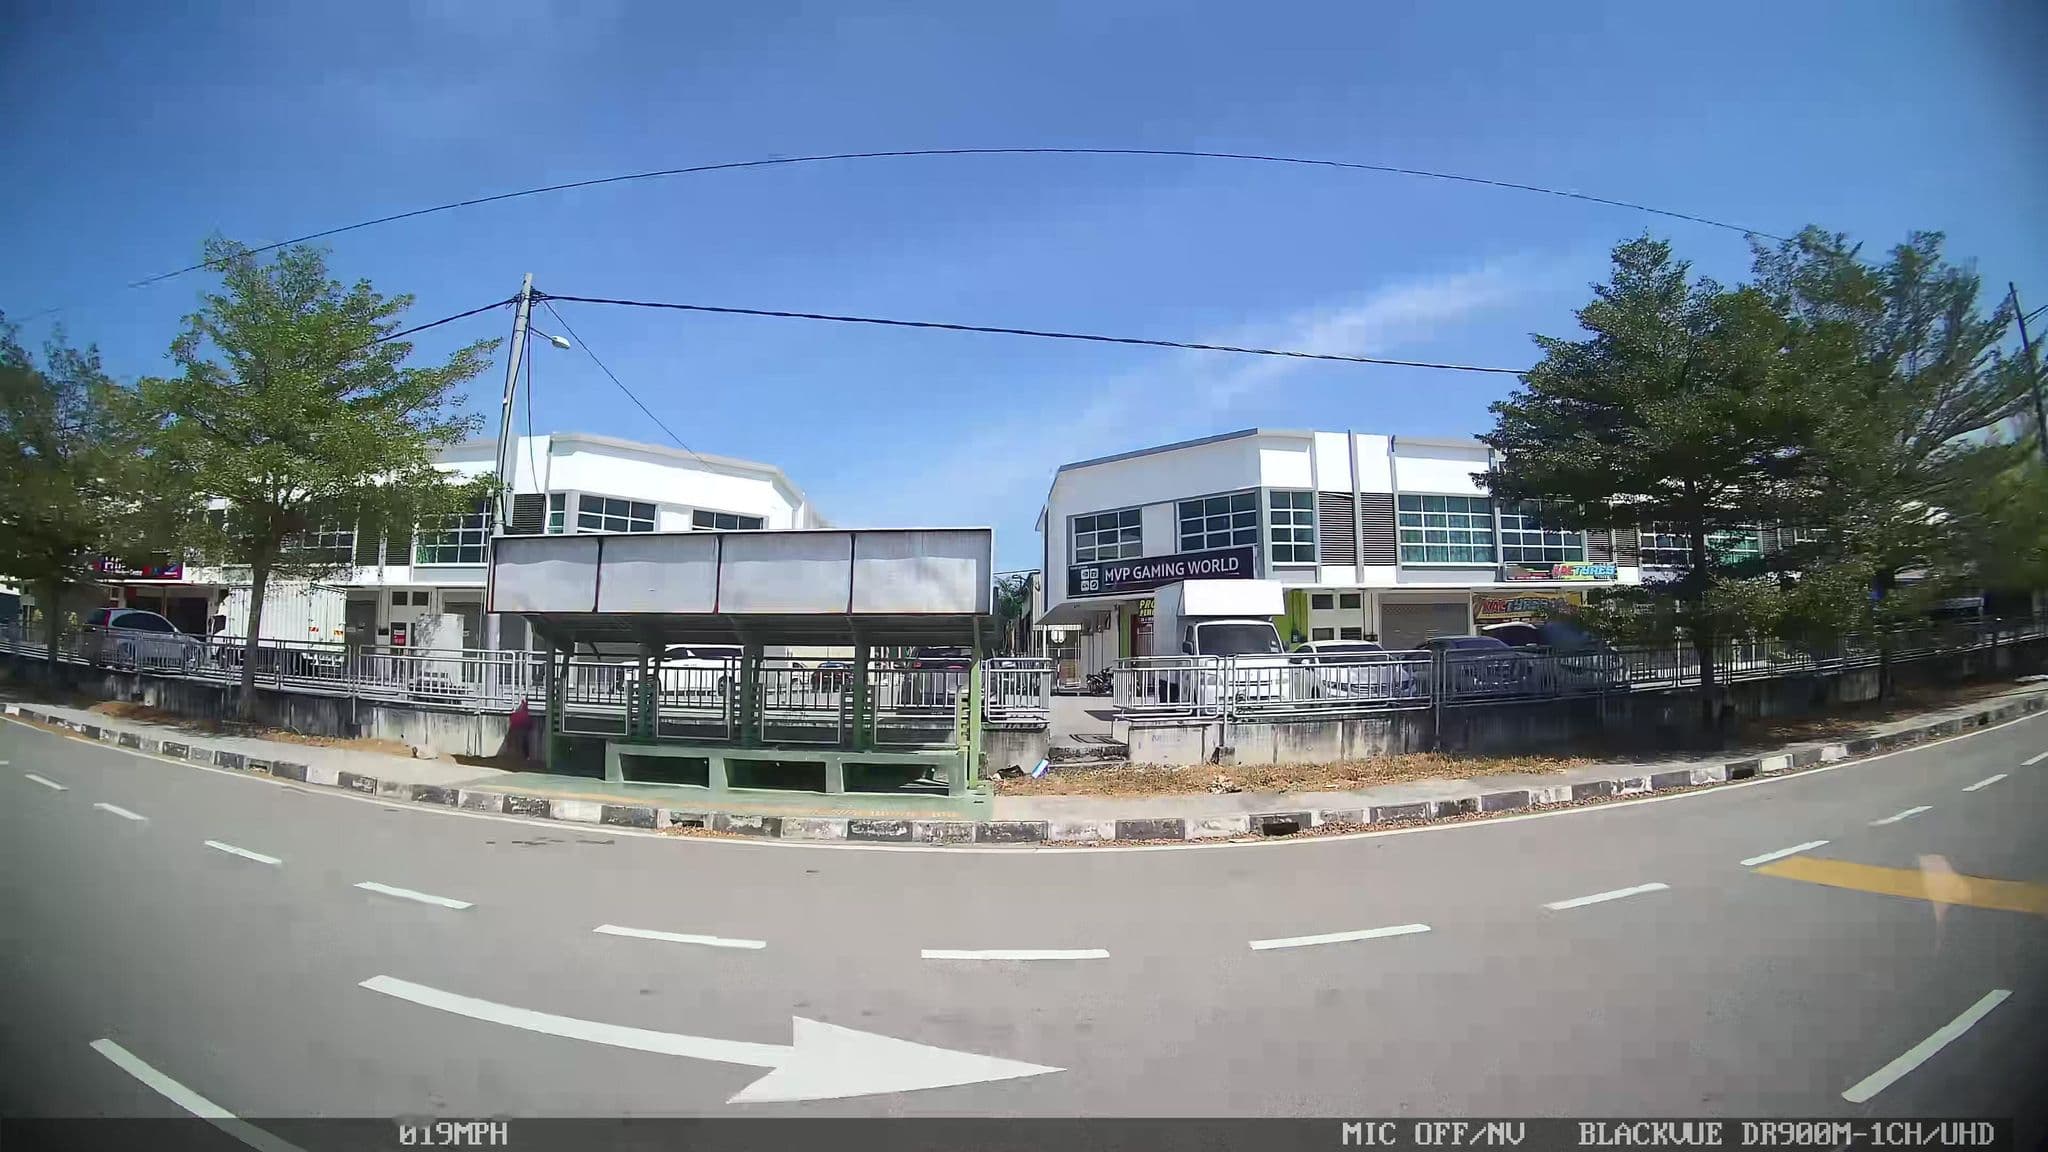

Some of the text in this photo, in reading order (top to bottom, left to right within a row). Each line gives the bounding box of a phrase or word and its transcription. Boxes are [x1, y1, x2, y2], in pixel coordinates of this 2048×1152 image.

[1104, 557, 1239, 582] MVP GAMING WORLD
